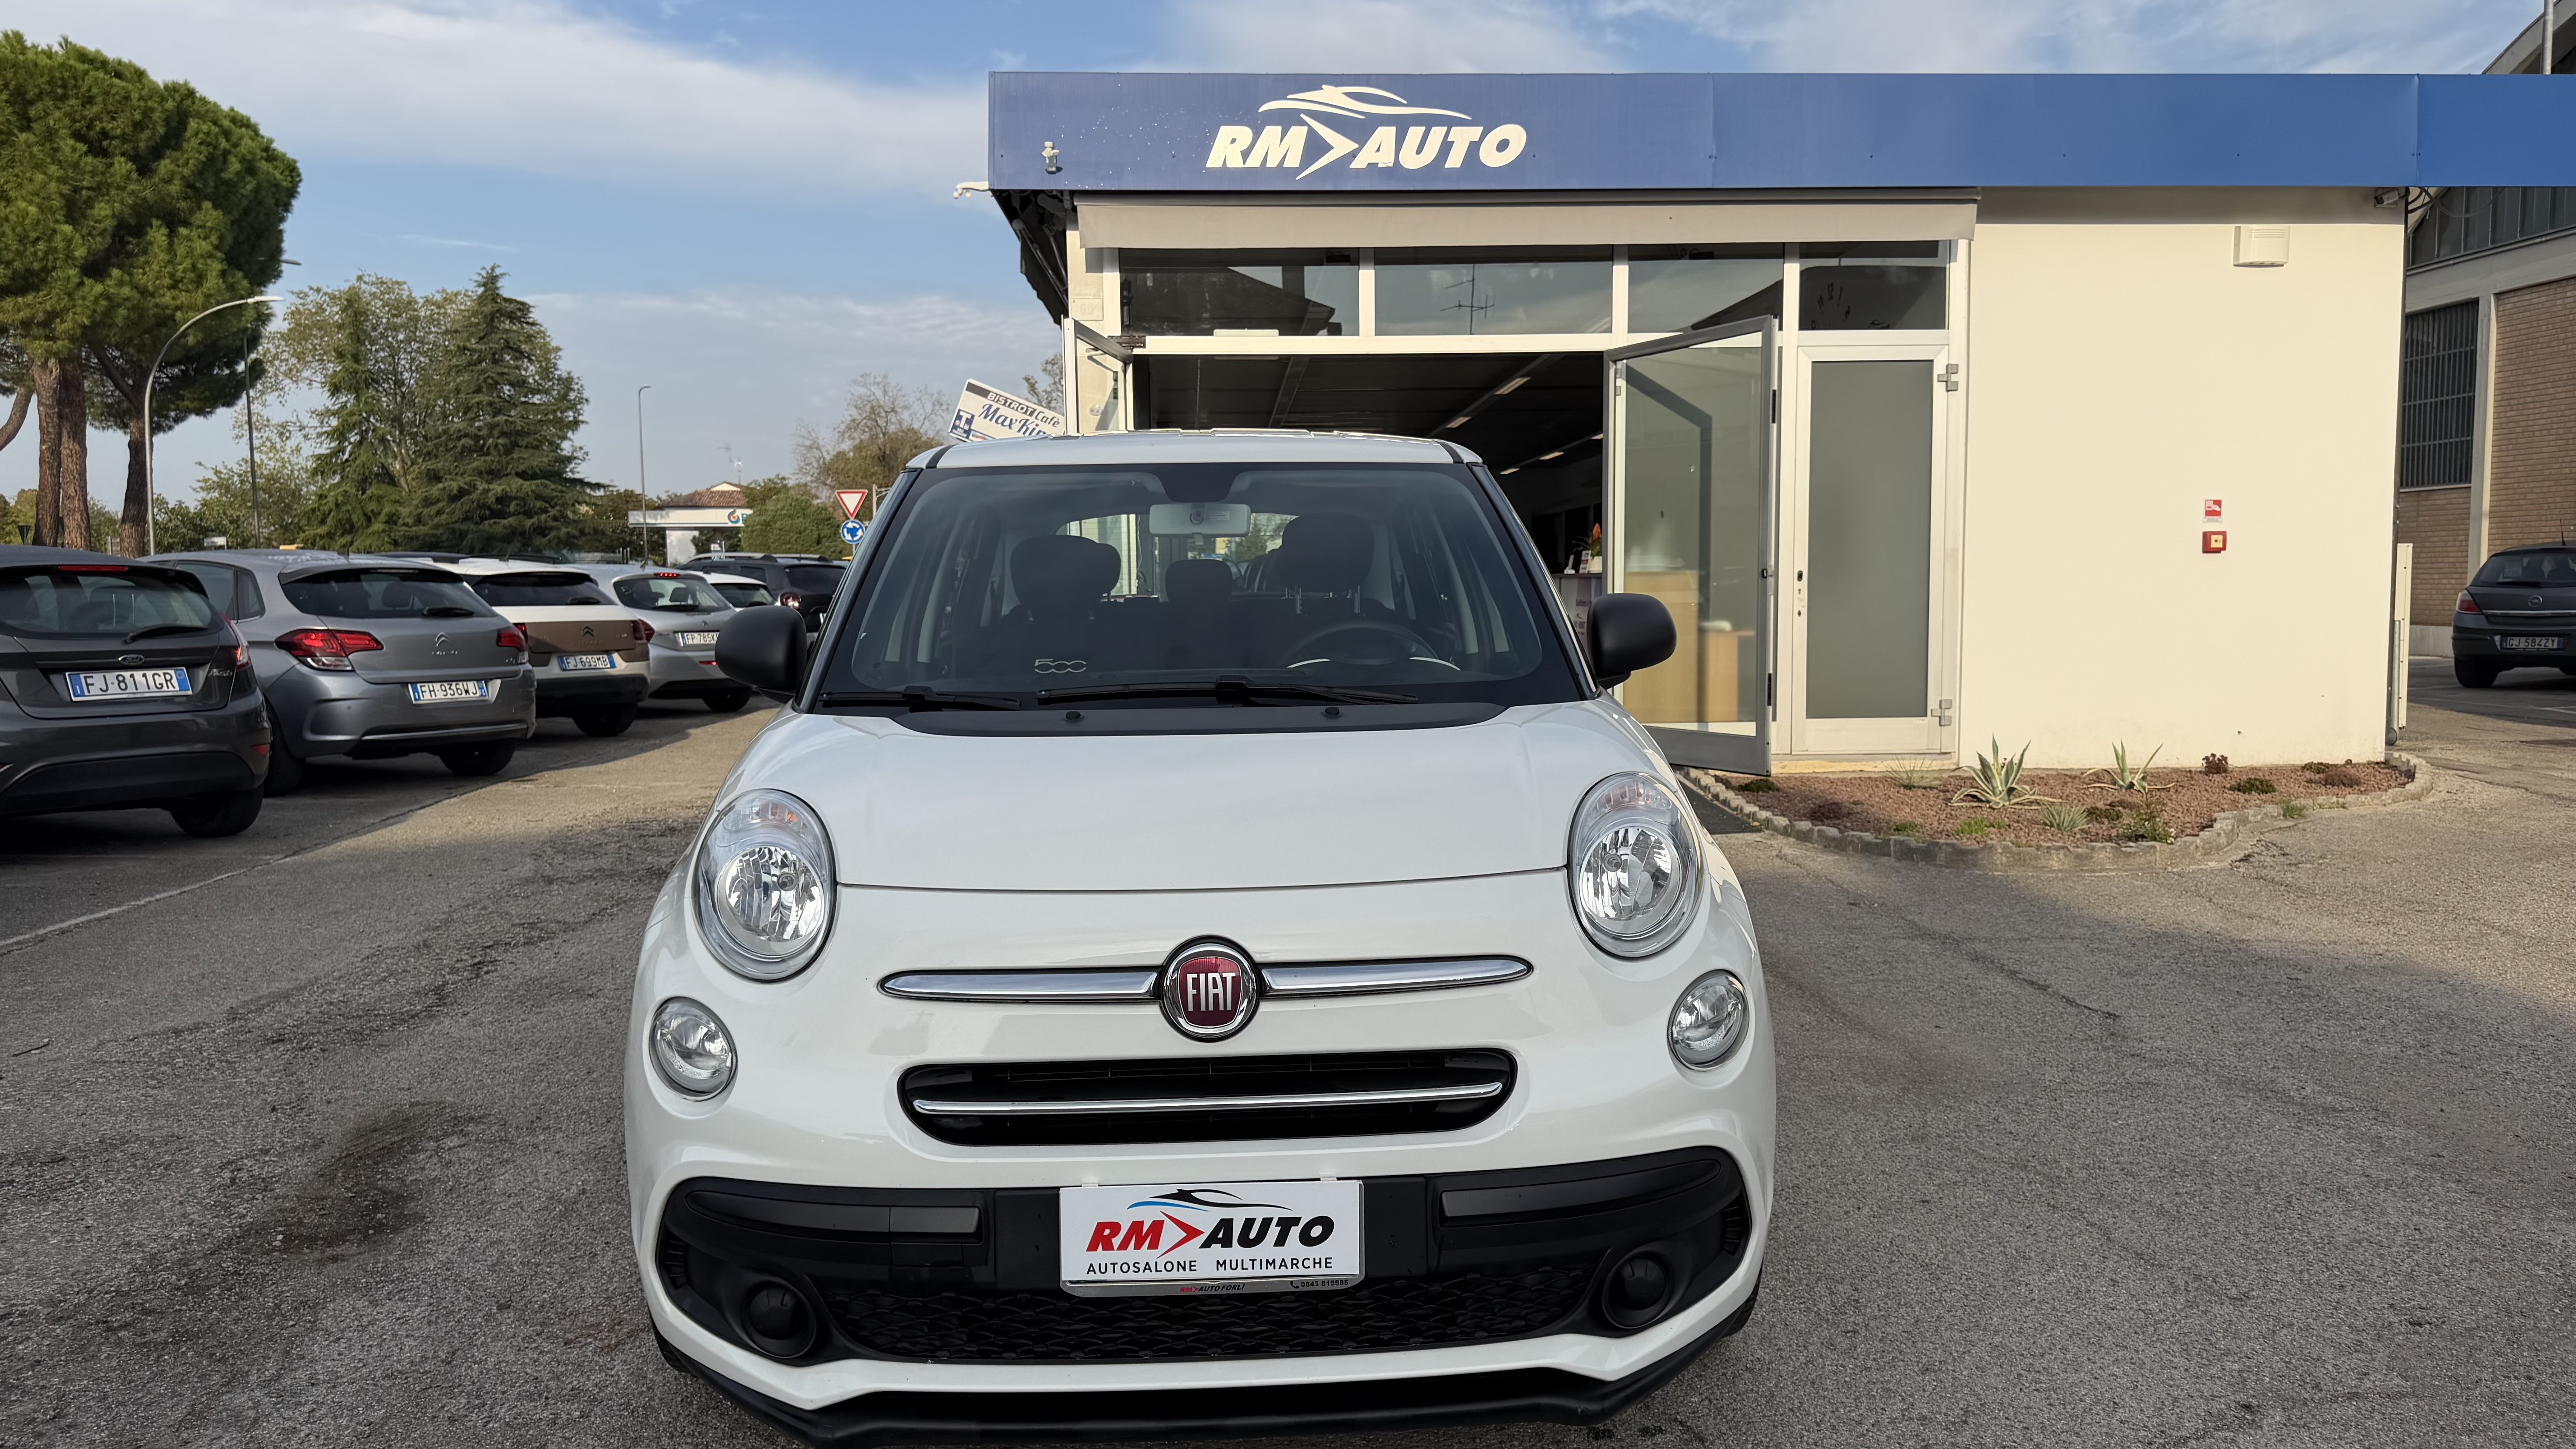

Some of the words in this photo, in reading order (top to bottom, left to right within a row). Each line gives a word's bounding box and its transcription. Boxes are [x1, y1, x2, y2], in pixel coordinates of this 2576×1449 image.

[1205, 126, 1308, 168] RM
[1349, 124, 1527, 169] AUTO
[987, 392, 1035, 415] BISTROT
[2508, 638, 2521, 648] GJ
[565, 657, 578, 668] FJ
[580, 656, 608, 667] 699MB
[1035, 659, 1086, 673] 500
[84, 674, 110, 694] FJ
[115, 672, 176, 691] 811GR
[419, 685, 437, 699] FH
[440, 682, 478, 697] 936WJ
[1187, 972, 1236, 1011] FIAT
[1086, 1219, 1165, 1252] RM
[1199, 1216, 1335, 1249] AUTO
[1086, 1260, 1197, 1275] AUTOSALONE
[1216, 1257, 1333, 1271] MULTIMARCHE
